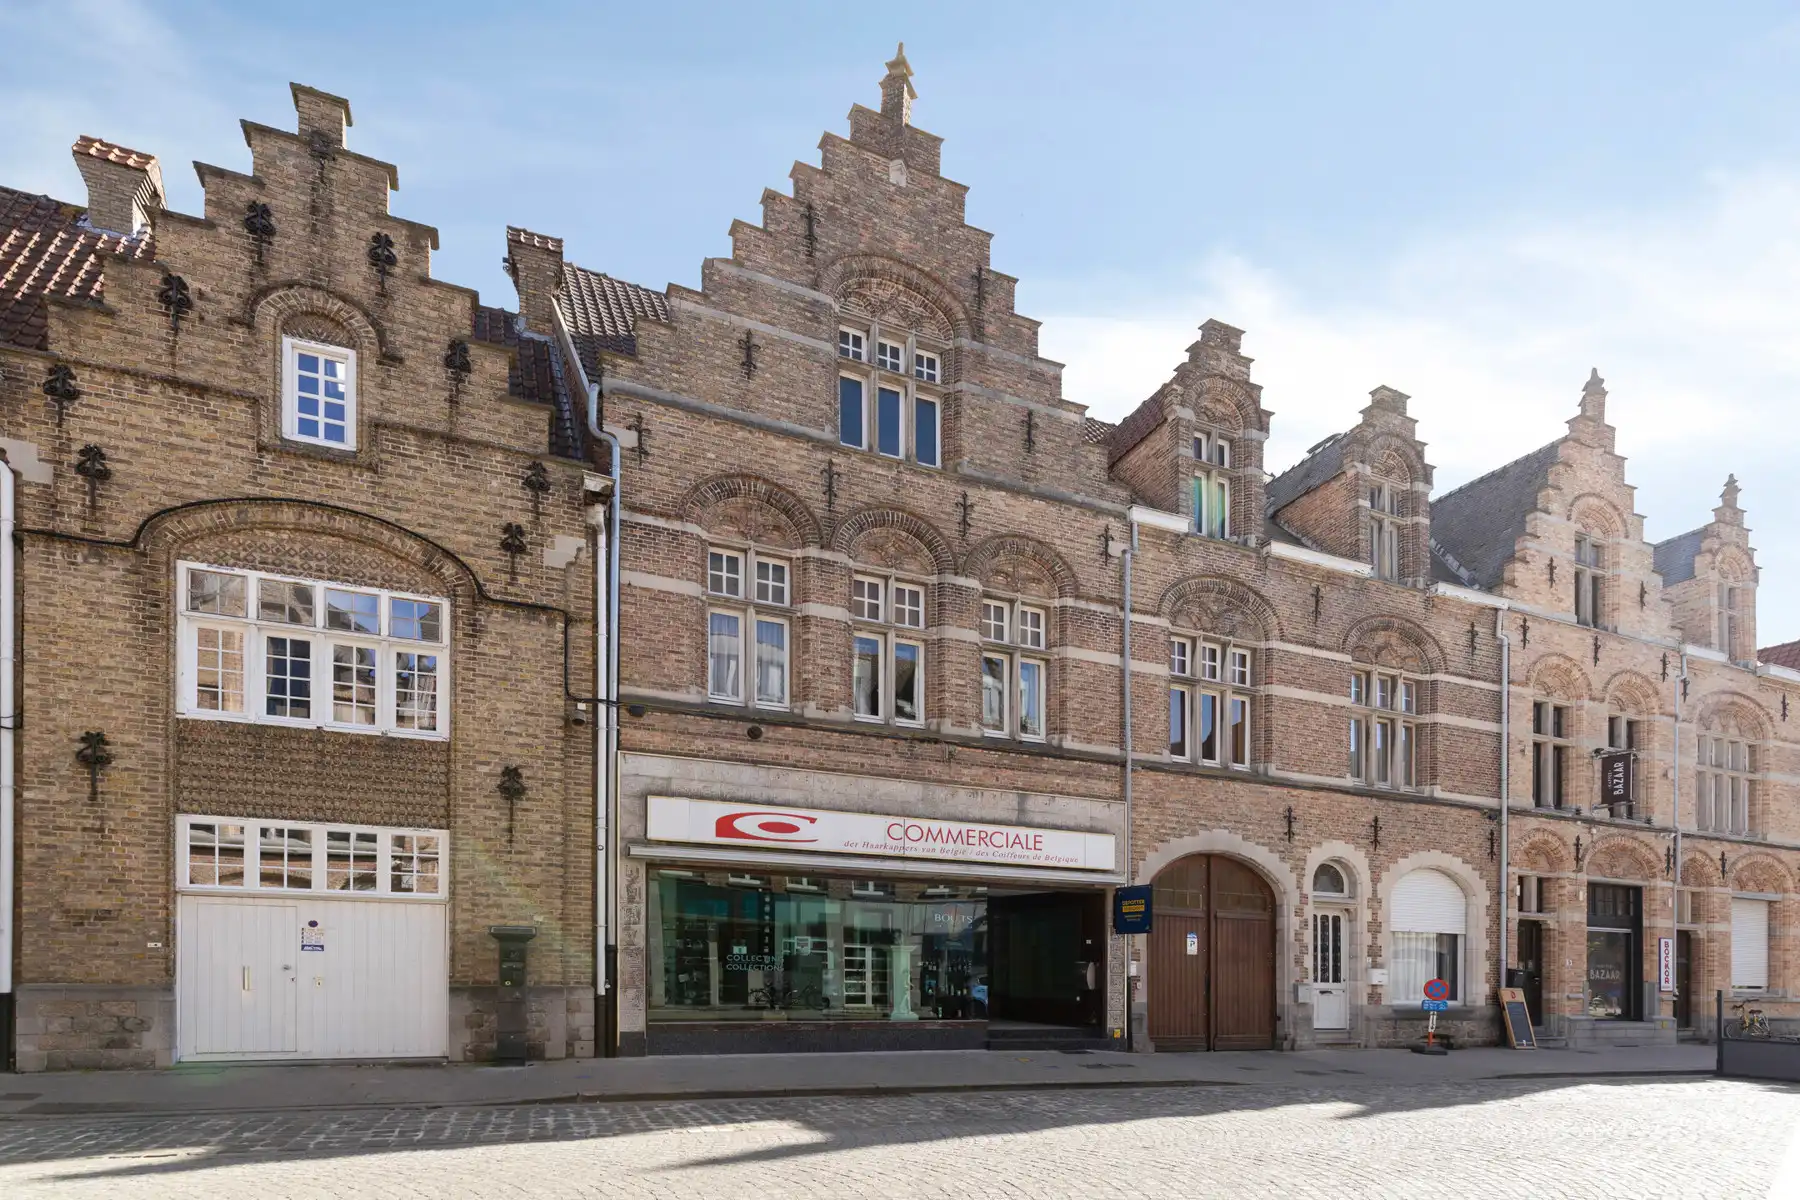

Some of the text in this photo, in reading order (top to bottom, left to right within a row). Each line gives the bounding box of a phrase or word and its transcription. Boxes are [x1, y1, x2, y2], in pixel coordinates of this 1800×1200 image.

[1613, 761, 1624, 795] BAZAAR
[887, 823, 1043, 851] COMMERCIALE
[844, 840, 858, 848] der
[862, 841, 918, 853] Haarkappers
[992, 850, 1030, 860] Coiffeurs
[1033, 852, 1042, 860] de
[1045, 854, 1079, 864] Belgique
[1590, 969, 1621, 980] BAZAAR
